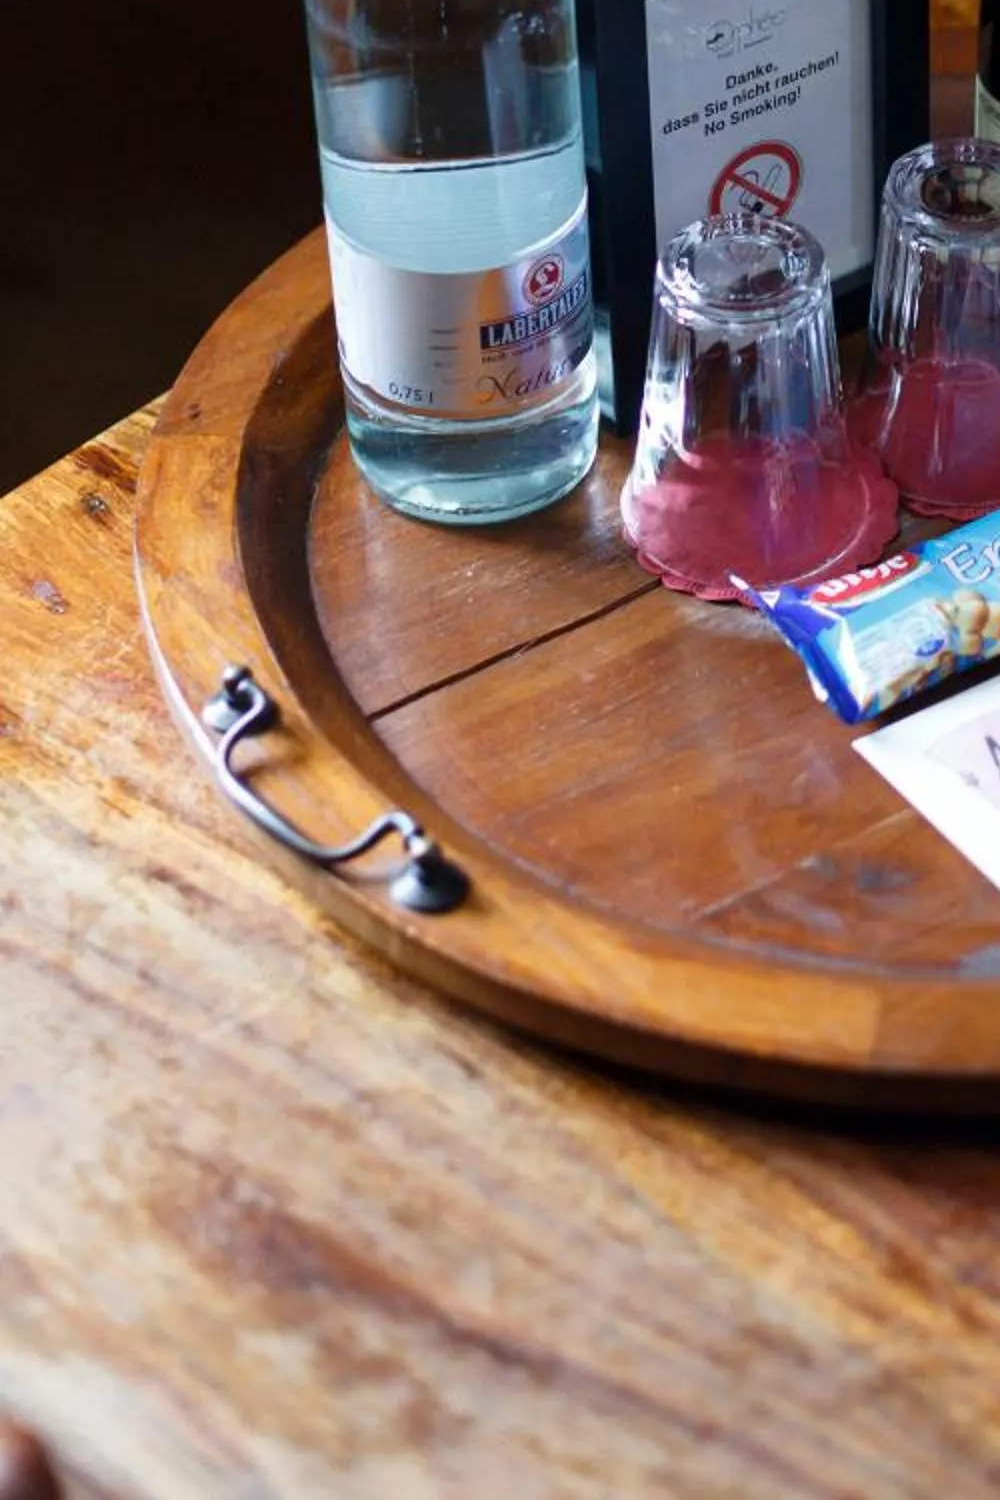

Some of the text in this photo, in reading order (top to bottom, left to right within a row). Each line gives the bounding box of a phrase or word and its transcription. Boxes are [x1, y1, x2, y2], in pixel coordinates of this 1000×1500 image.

[662, 51, 840, 135] dass Sie nicht rauchen!
[725, 62, 778, 90] Danke,
[704, 86, 802, 137] No Smoking!
[389, 381, 423, 401] 0,75
